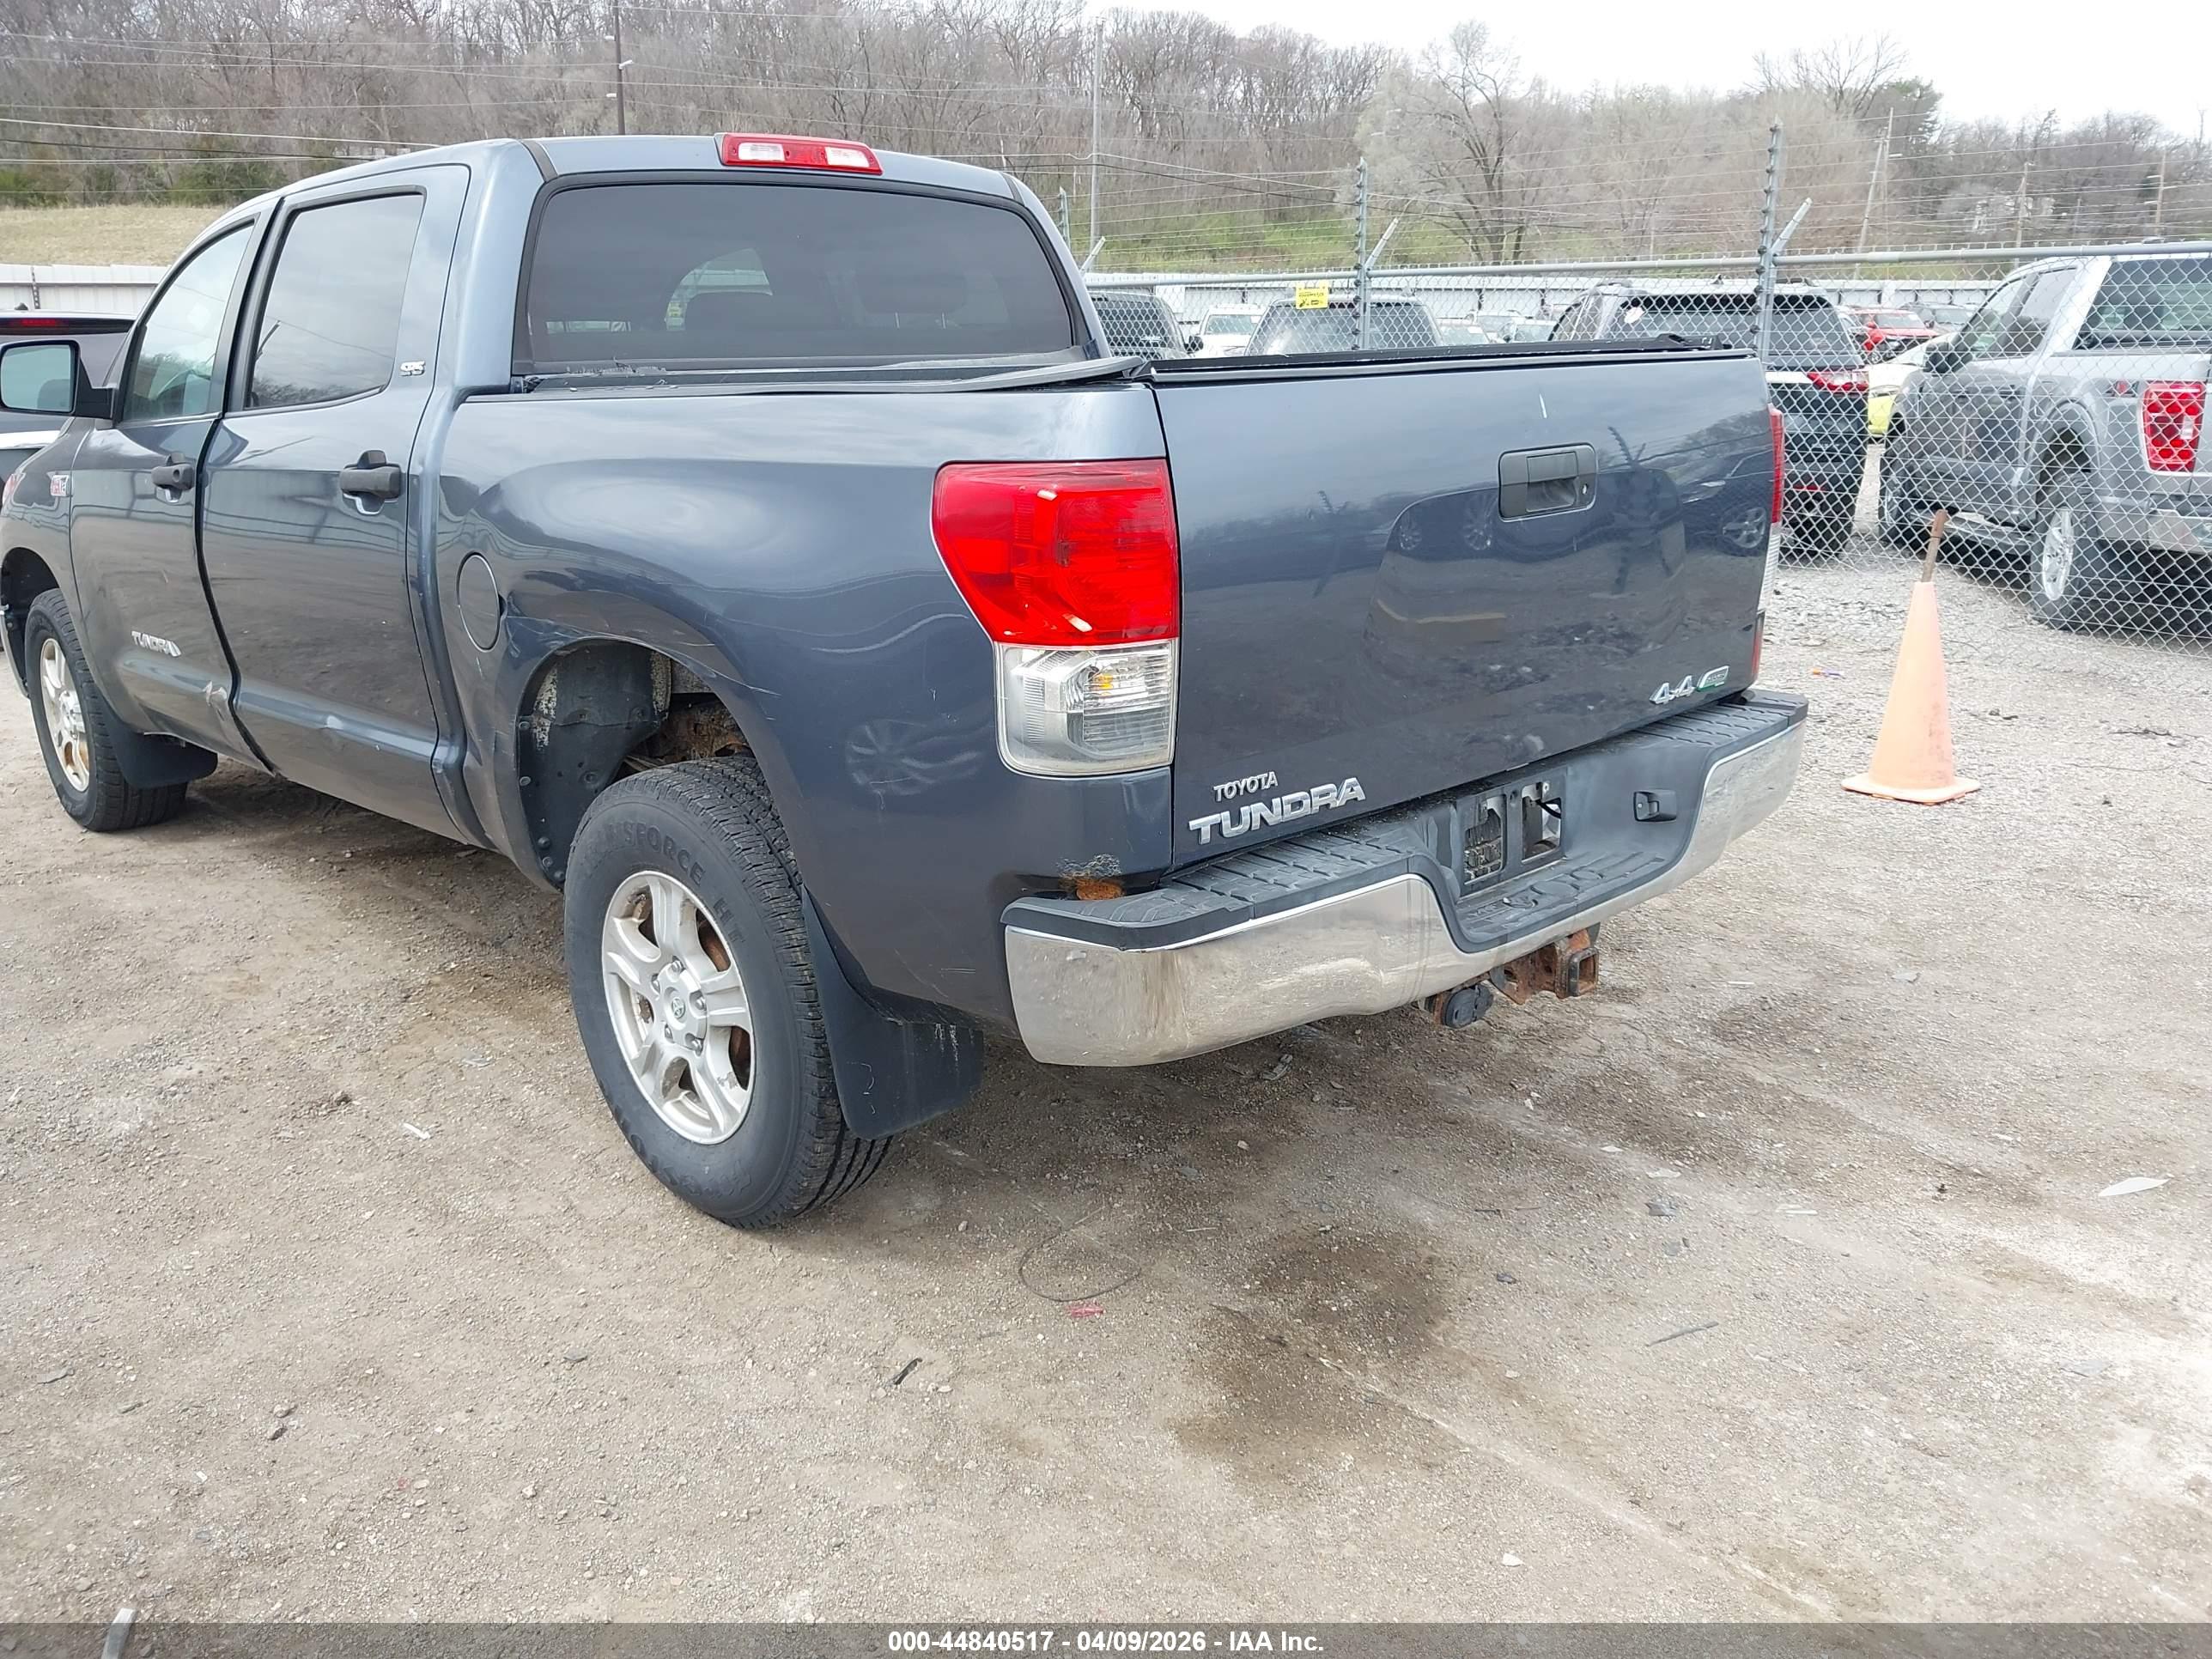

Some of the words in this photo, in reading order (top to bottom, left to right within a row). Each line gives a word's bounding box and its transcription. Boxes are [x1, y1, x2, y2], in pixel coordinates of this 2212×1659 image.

[131, 630, 182, 657] TUNDRA
[1213, 771, 1279, 802] TOYOTA
[1188, 777, 1365, 845] TUNDRA
